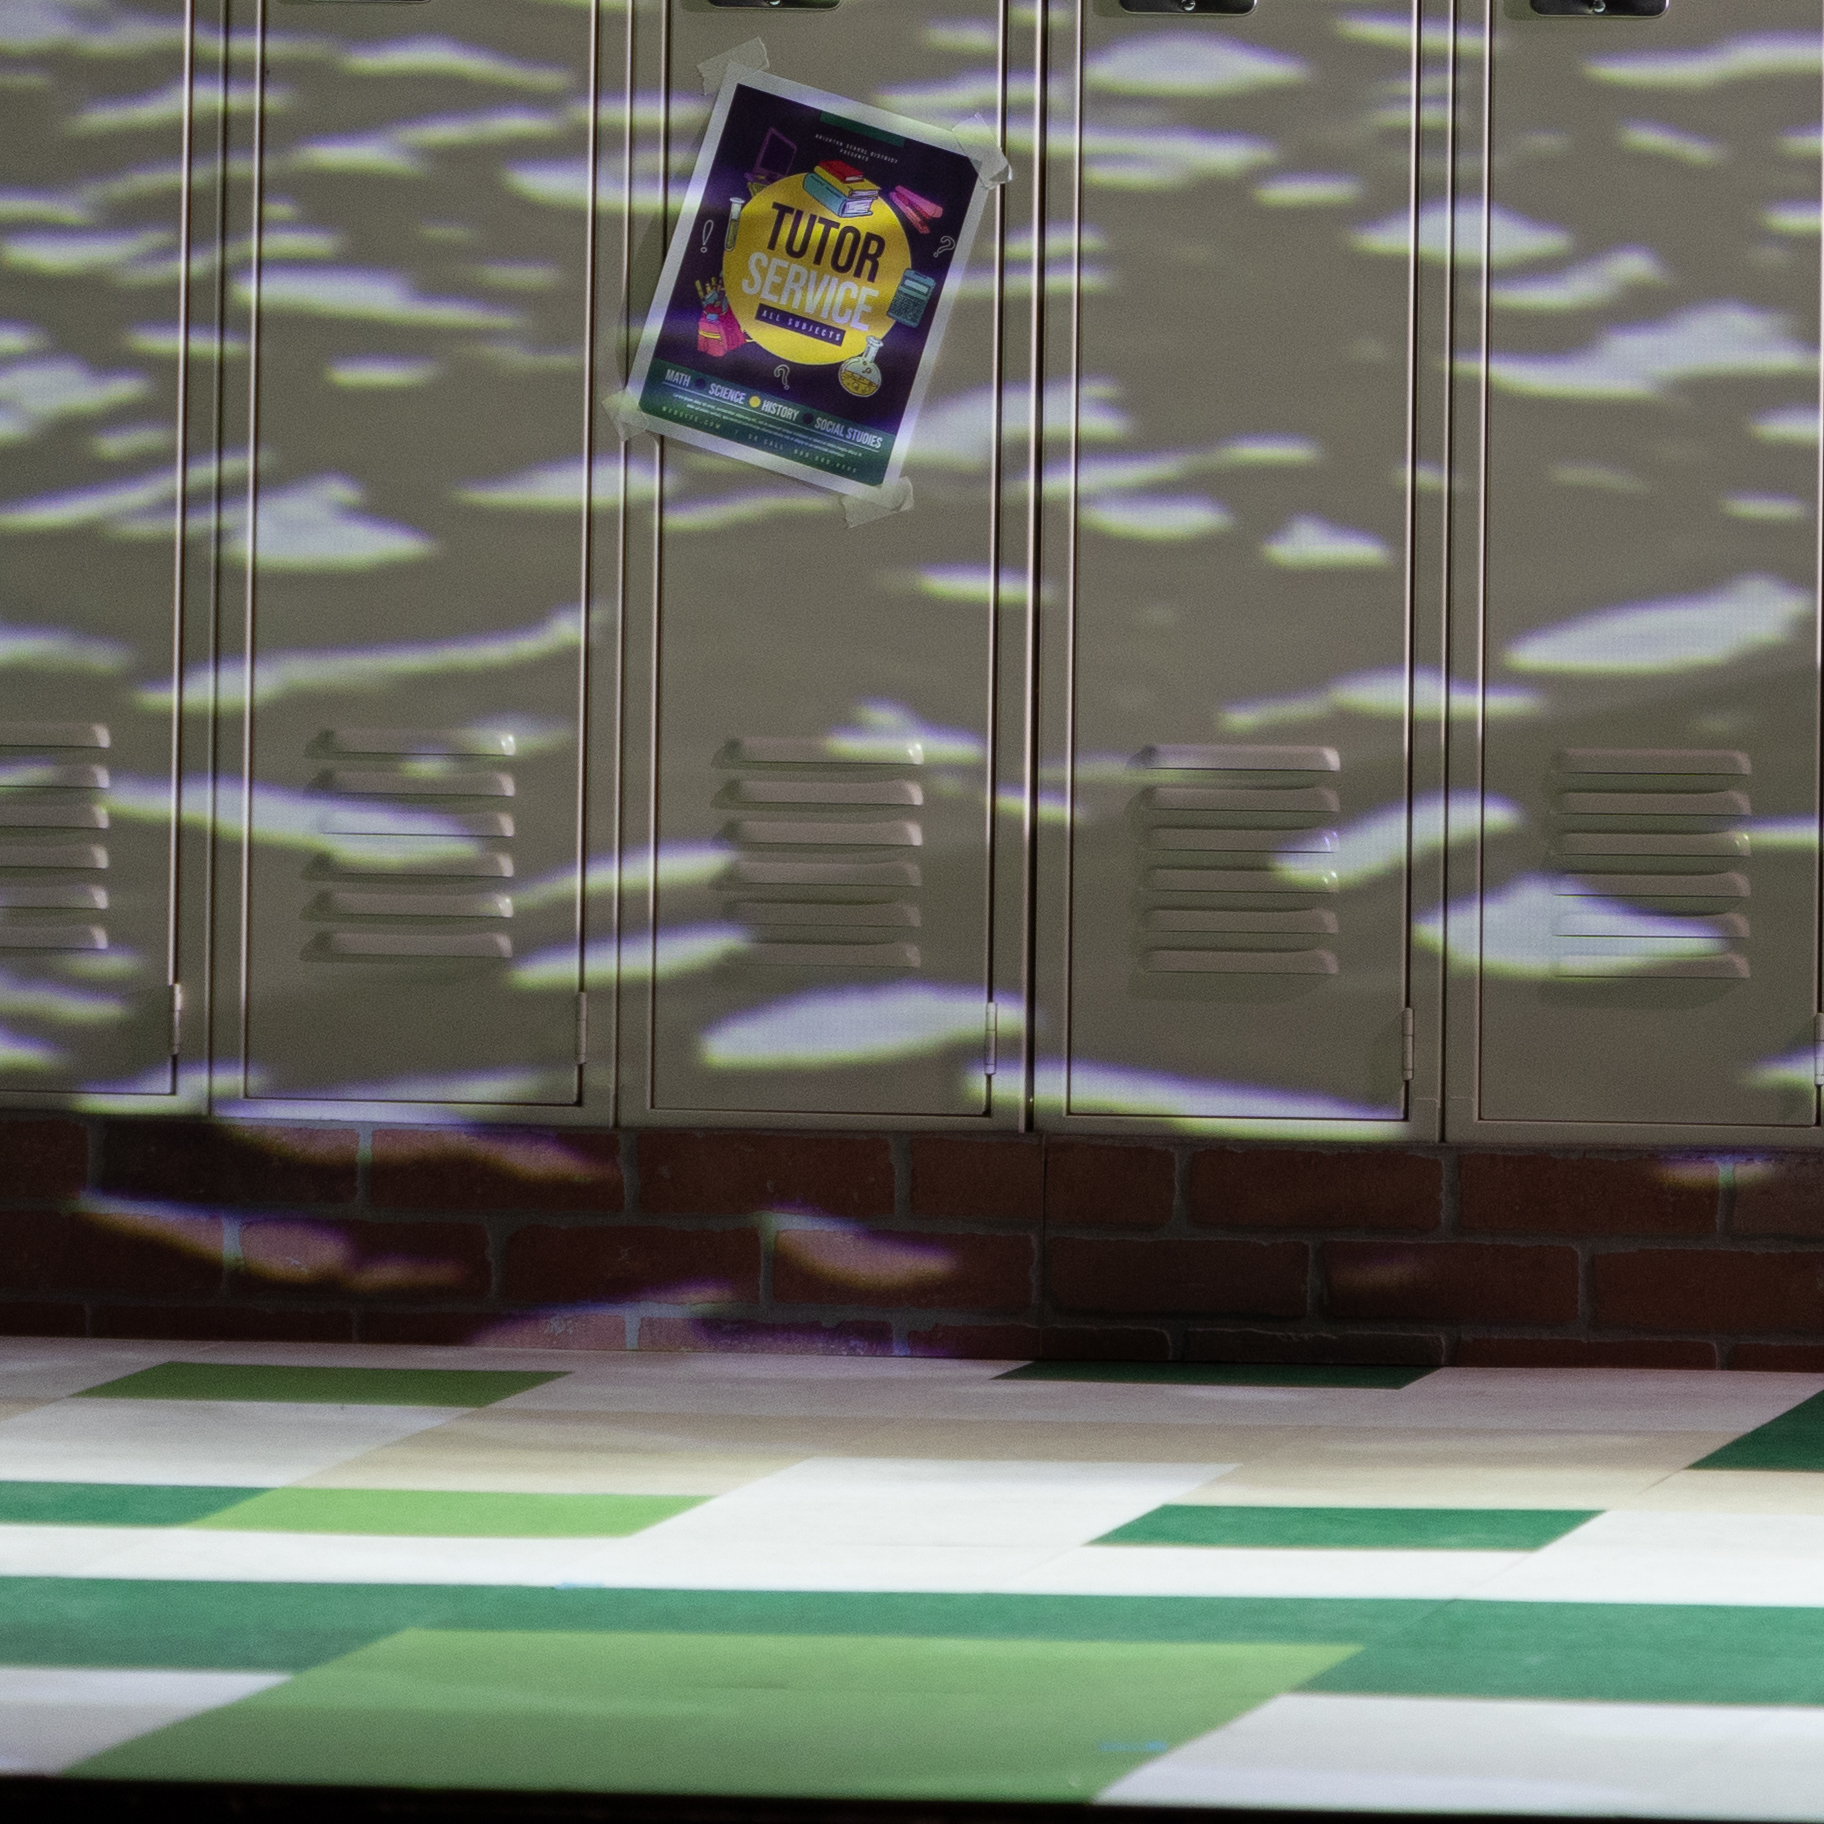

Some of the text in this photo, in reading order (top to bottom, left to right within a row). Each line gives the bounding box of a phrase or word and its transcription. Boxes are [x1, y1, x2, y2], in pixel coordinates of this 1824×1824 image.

[767, 201, 886, 283] TUTOR
[741, 251, 880, 332] SERVICE
[761, 309, 842, 341] ALL SUBJECTS
[665, 369, 692, 387] MATH
[708, 383, 747, 405] SCIENCE
[761, 400, 800, 421] HISTORY
[814, 417, 845, 437] SOCIAL
[847, 427, 883, 449] STUDIES
